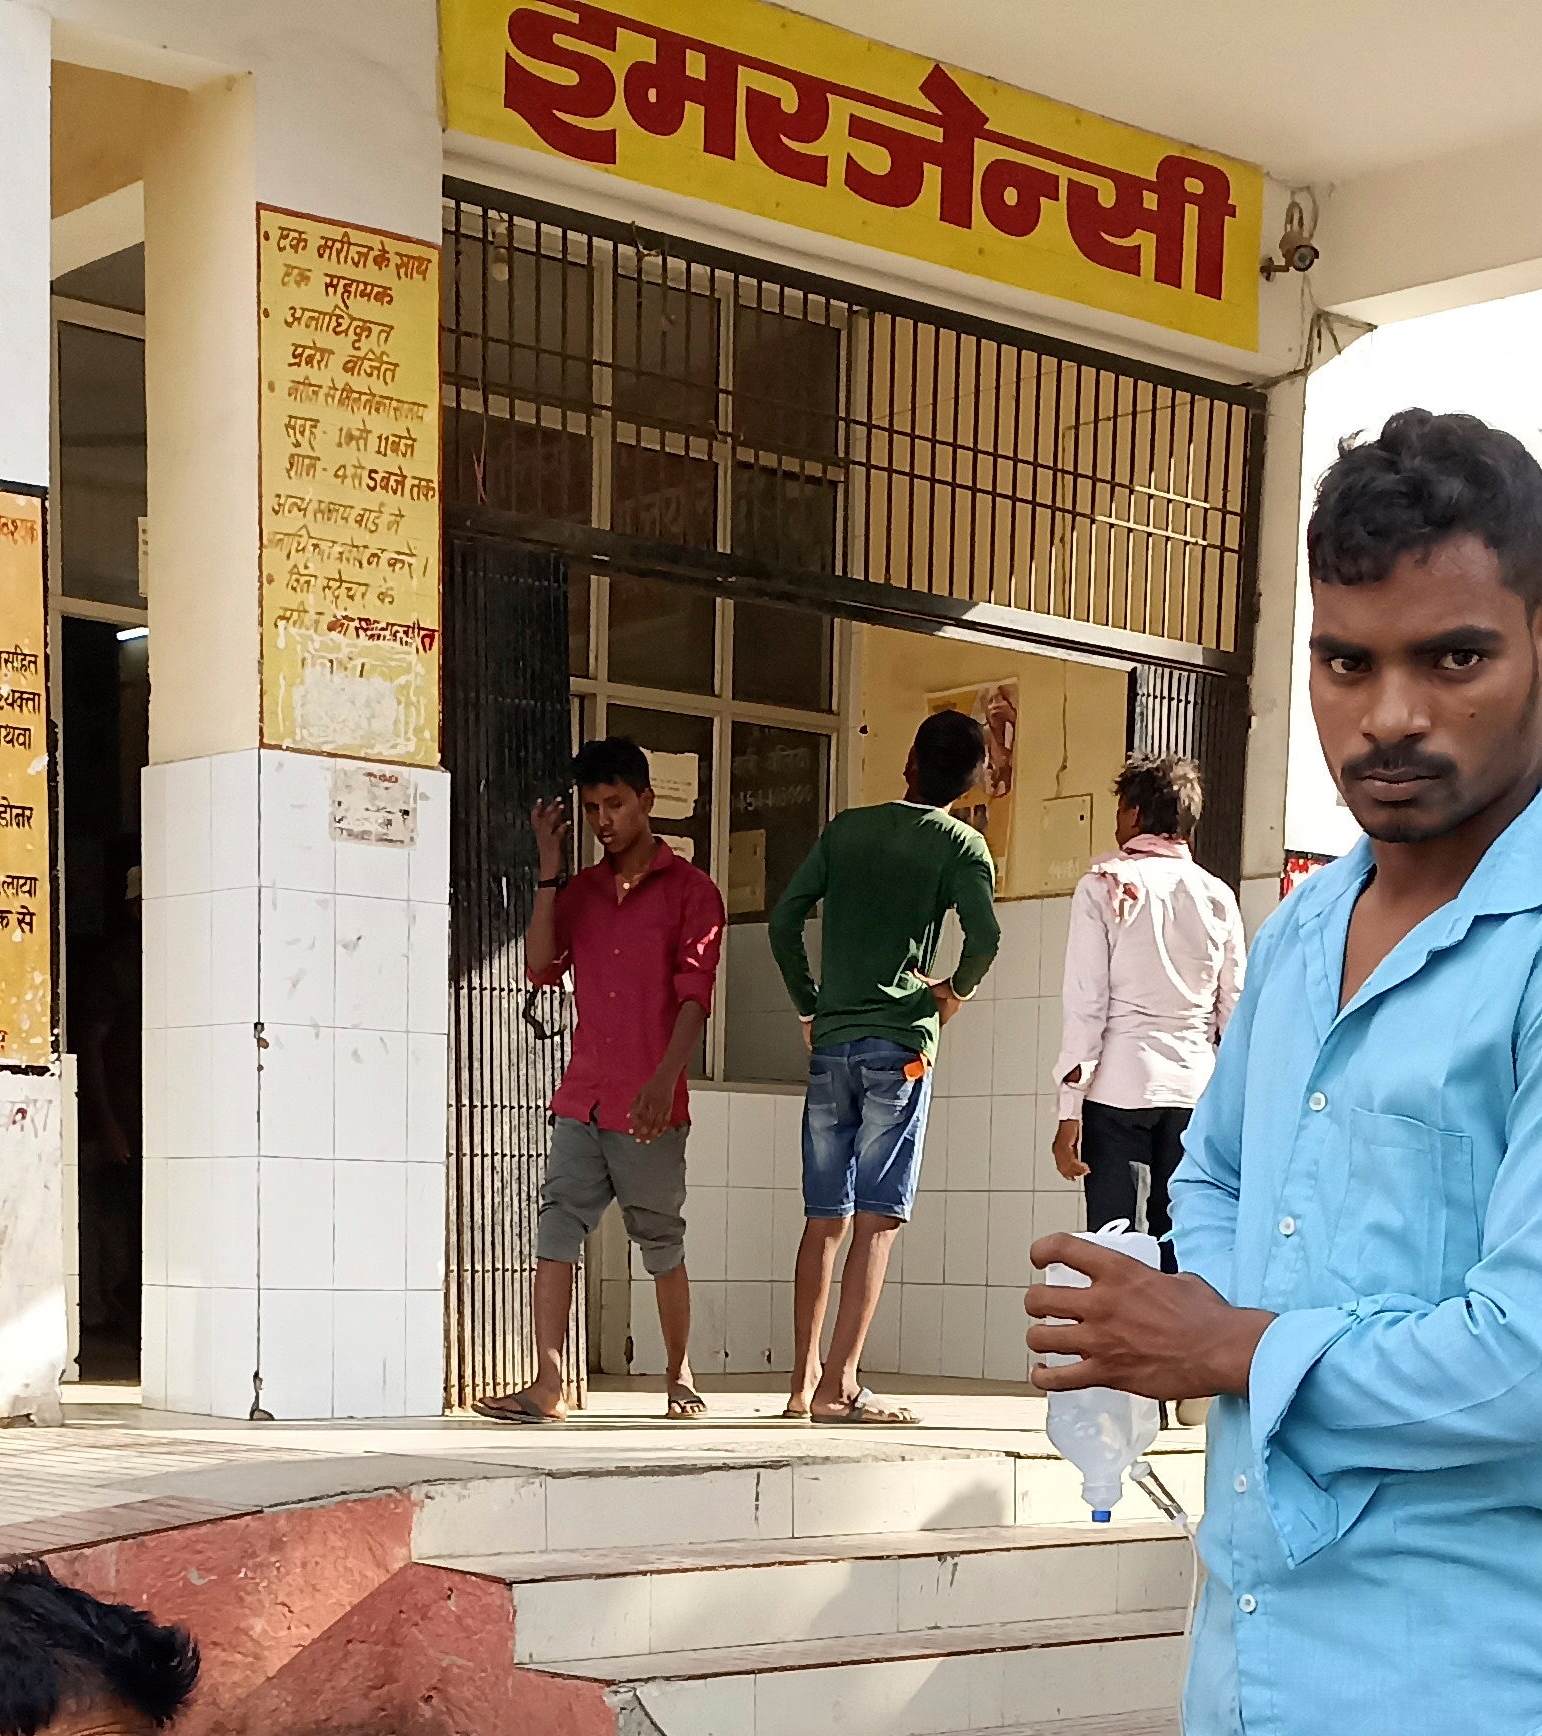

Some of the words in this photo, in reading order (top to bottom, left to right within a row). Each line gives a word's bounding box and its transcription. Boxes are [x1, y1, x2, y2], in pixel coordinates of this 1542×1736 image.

[503, 0, 1236, 301] इमरजेन्सी
[277, 225, 309, 253] एक
[316, 231, 374, 269] मरीज
[372, 240, 391, 271] के
[394, 251, 432, 281] साथ
[323, 272, 394, 310] सहायक
[410, 476, 436, 501] तक
[15, 905, 36, 934] से
